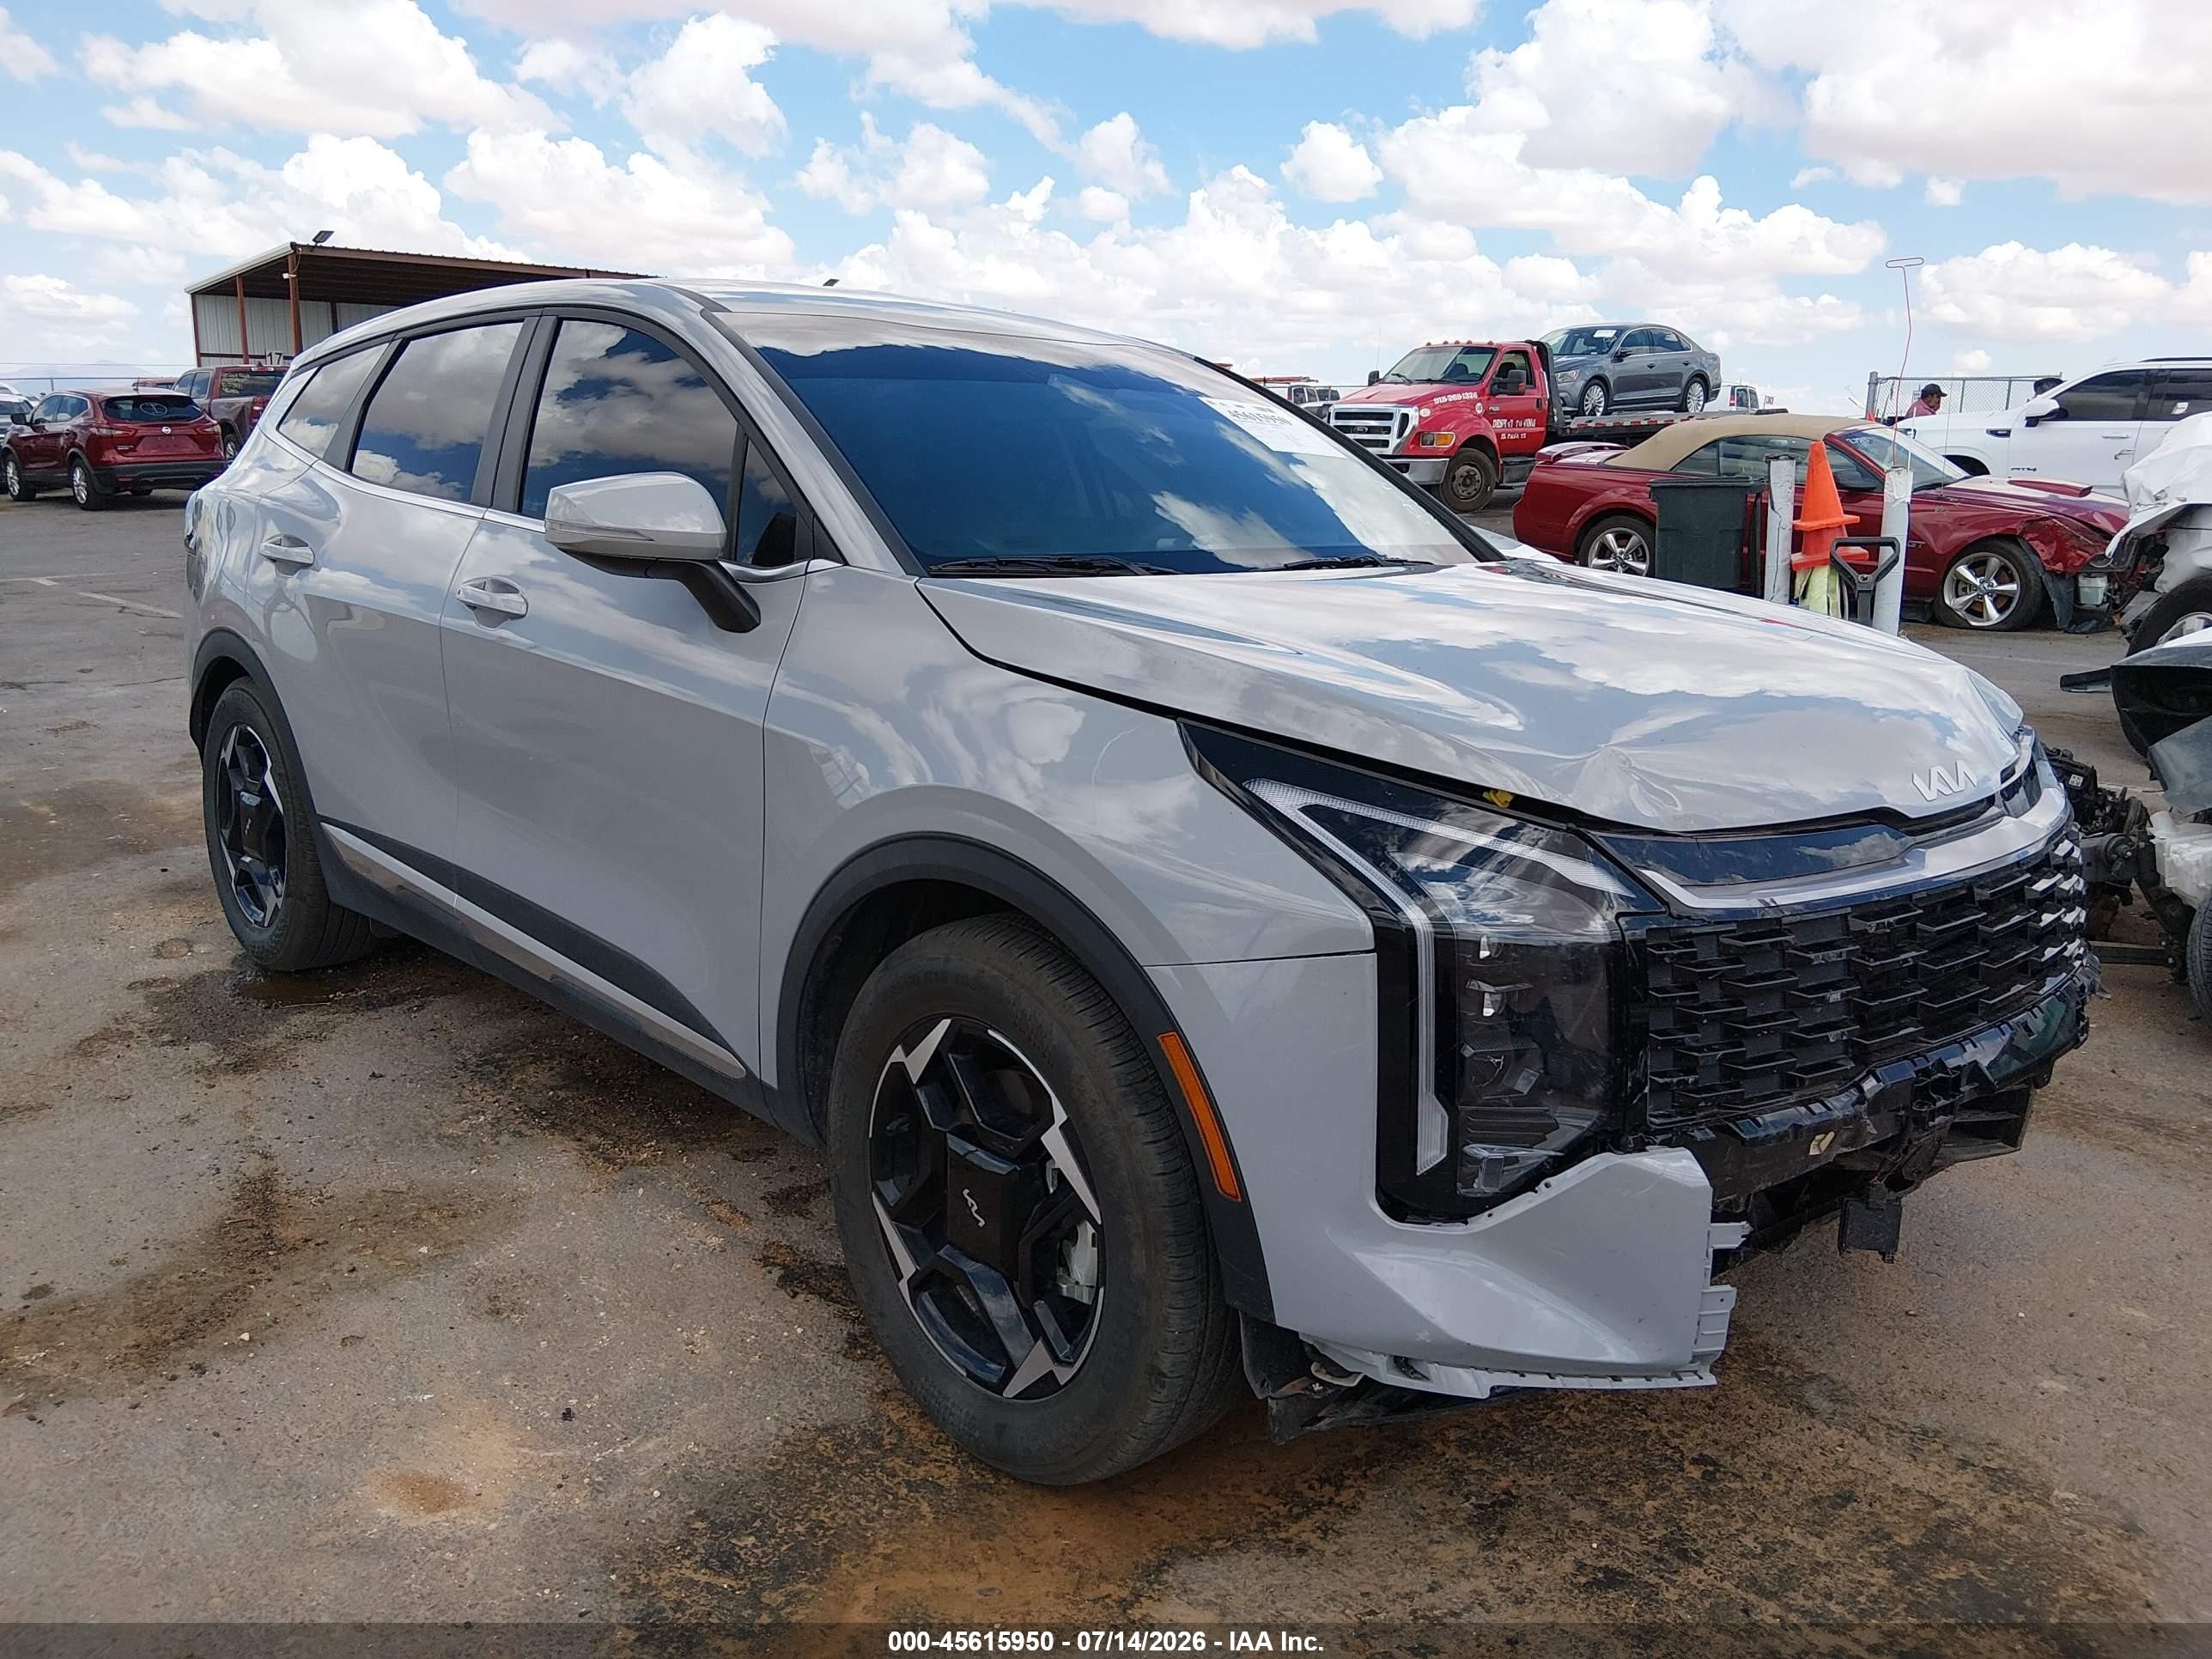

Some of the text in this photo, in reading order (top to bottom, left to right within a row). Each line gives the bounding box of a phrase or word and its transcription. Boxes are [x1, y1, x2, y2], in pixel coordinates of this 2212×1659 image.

[267, 351, 283, 365] 17
[1227, 410, 1292, 426] 45615950
[1911, 759, 1978, 803] KIA
